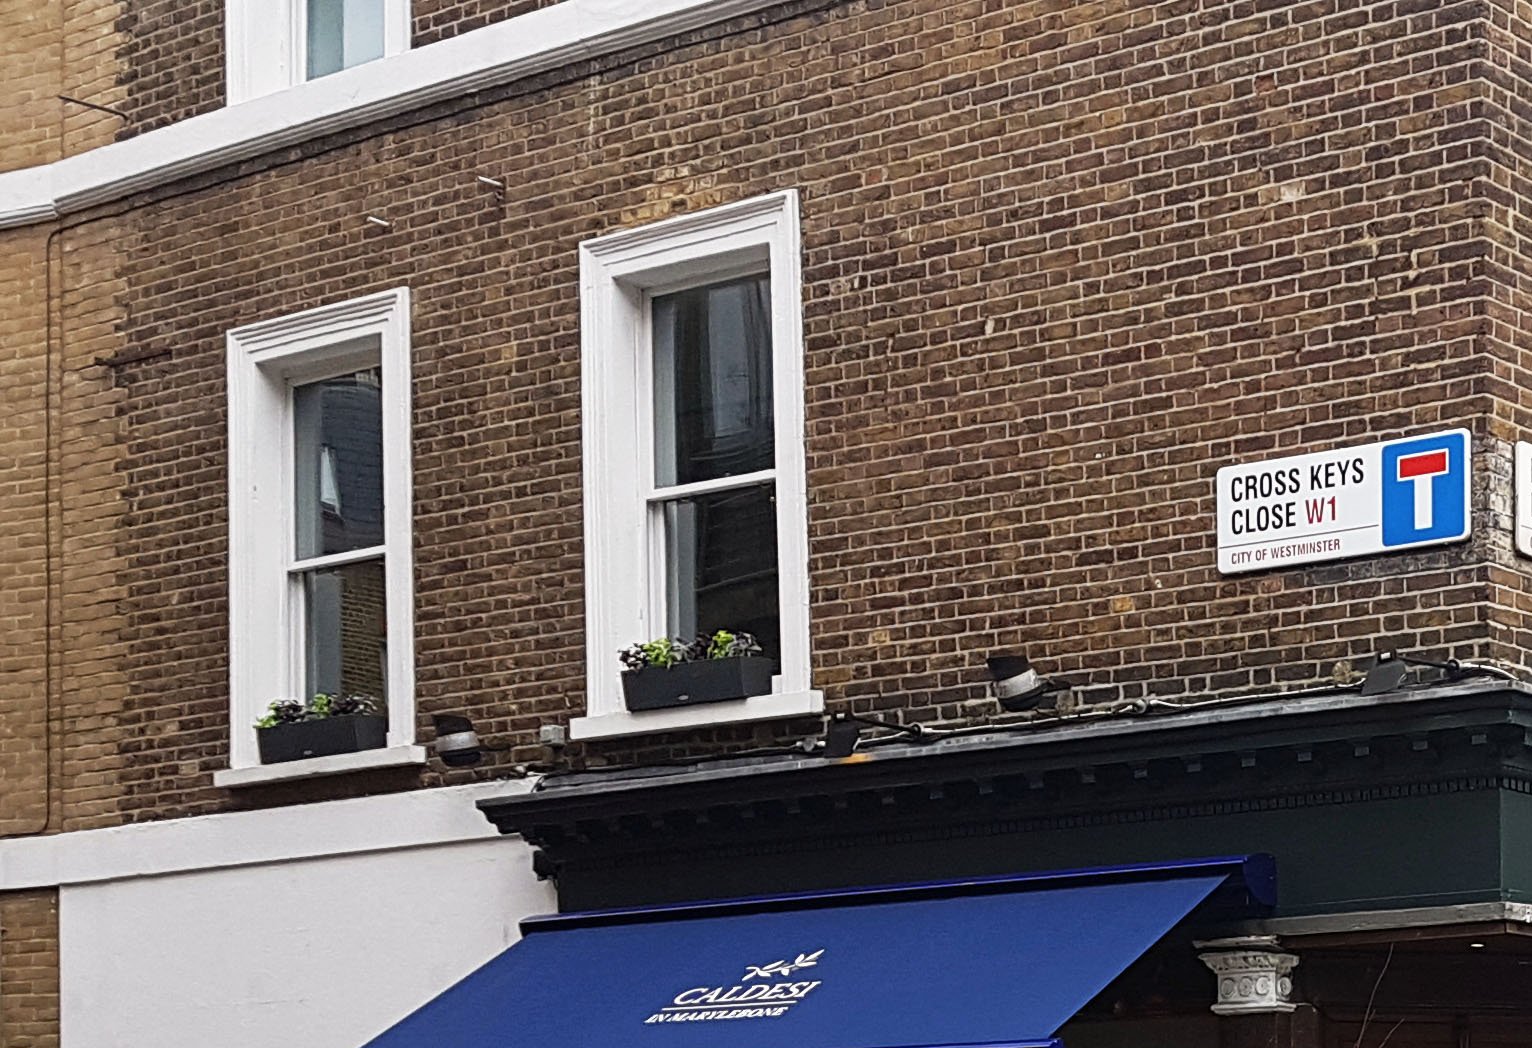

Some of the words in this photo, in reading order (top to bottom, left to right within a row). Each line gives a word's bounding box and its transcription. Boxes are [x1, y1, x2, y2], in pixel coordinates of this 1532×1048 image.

[1230, 468, 1301, 503] CROSS
[1309, 457, 1365, 492] KEYS
[1230, 500, 1297, 535] CLOSE
[1305, 495, 1337, 526] W1
[1230, 549, 1252, 565] CITY
[1255, 548, 1268, 561] OF
[1270, 538, 1341, 560] WESTMINSTER
[673, 981, 822, 1005] CALDESI
